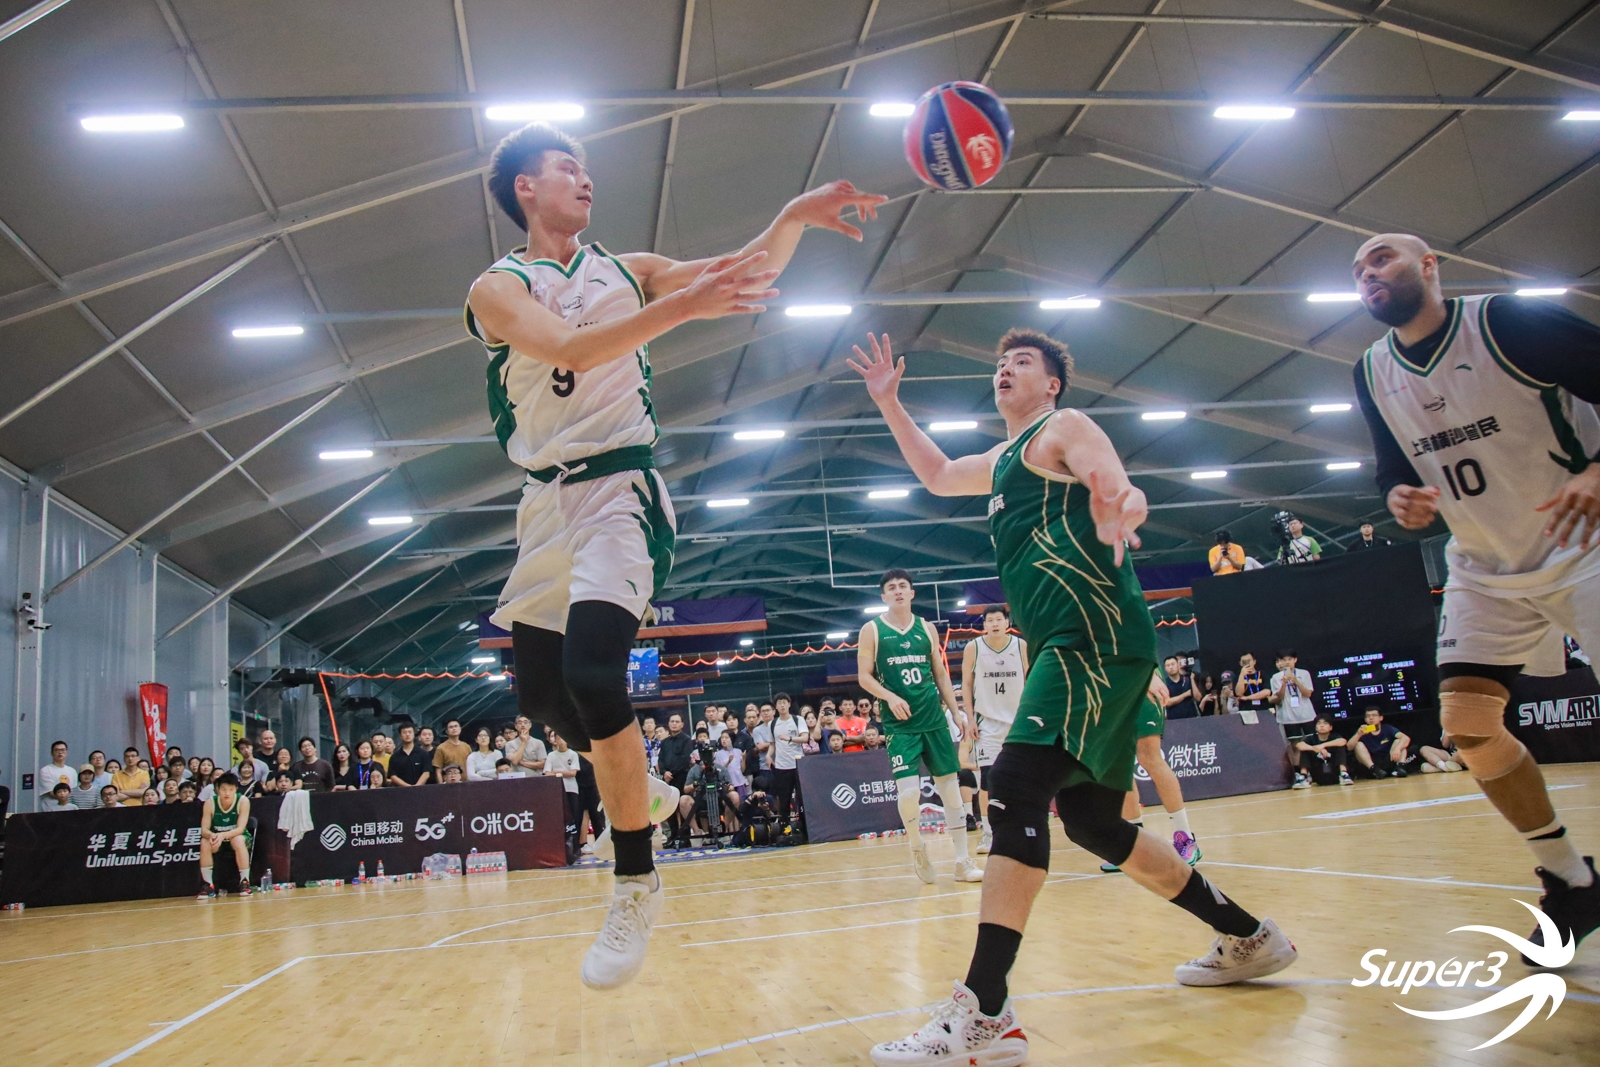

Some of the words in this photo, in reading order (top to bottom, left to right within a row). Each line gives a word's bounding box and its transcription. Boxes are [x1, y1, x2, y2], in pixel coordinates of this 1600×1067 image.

[551, 367, 575, 398] 9
[1442, 458, 1487, 501] 10
[901, 667, 922, 686] 30
[1397, 671, 1404, 680] 3
[995, 683, 1006, 695] 14
[1329, 679, 1341, 688] 13
[1360, 686, 1378, 694] 05:51
[978, 749, 985, 757] 14
[1168, 742, 1218, 769] 微博
[892, 755, 903, 767] 30
[859, 780, 896, 795] 中国移
[861, 795, 885, 804] China
[350, 820, 403, 837] 中国移动
[87, 828, 201, 852] 华夏北斗星
[351, 837, 375, 847] China
[376, 835, 403, 845] Mobile
[86, 852, 150, 868] Unilumin
[151, 849, 201, 866] Sports
